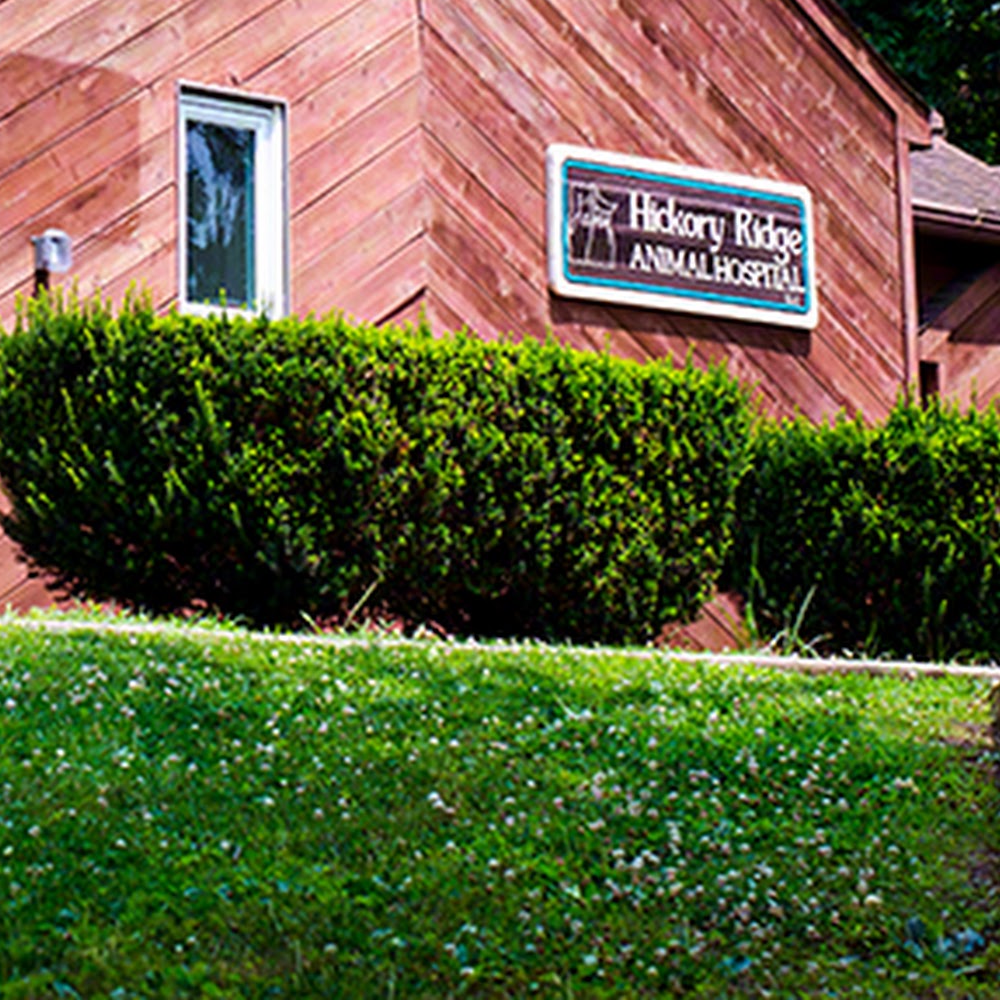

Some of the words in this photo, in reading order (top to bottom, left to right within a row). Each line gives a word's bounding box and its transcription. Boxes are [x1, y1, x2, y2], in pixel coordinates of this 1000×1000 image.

[629, 191, 725, 253] Hickory
[735, 207, 803, 265] Ridge
[629, 243, 713, 281] ANIMAL
[713, 254, 806, 293] HOSPITAL
